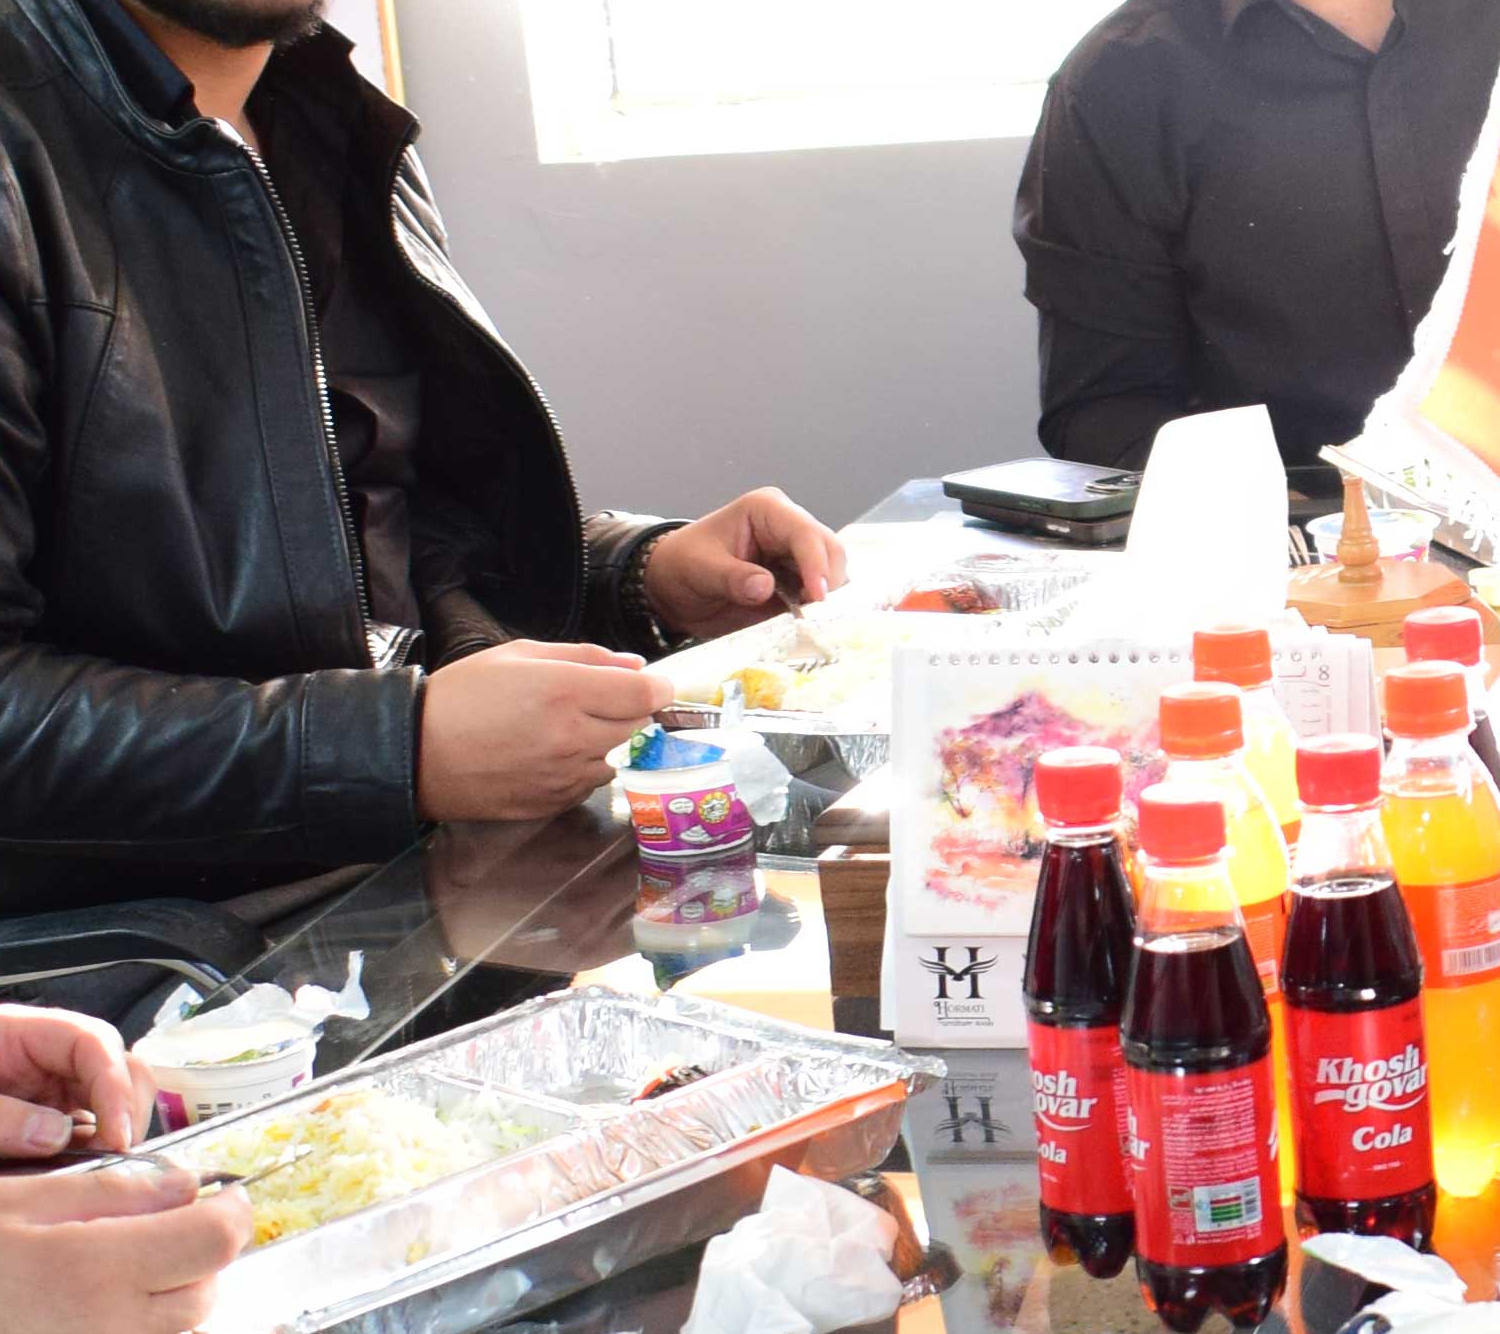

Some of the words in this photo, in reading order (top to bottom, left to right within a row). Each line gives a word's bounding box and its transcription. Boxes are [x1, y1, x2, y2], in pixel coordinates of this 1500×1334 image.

[1316, 1043, 1420, 1084] Khosh
[1032, 1069, 1077, 1097] osh
[1342, 1061, 1428, 1112] govar
[1035, 1093, 1099, 1118] ovar
[1352, 1123, 1413, 1151] Cola
[1038, 1141, 1067, 1164] ola
